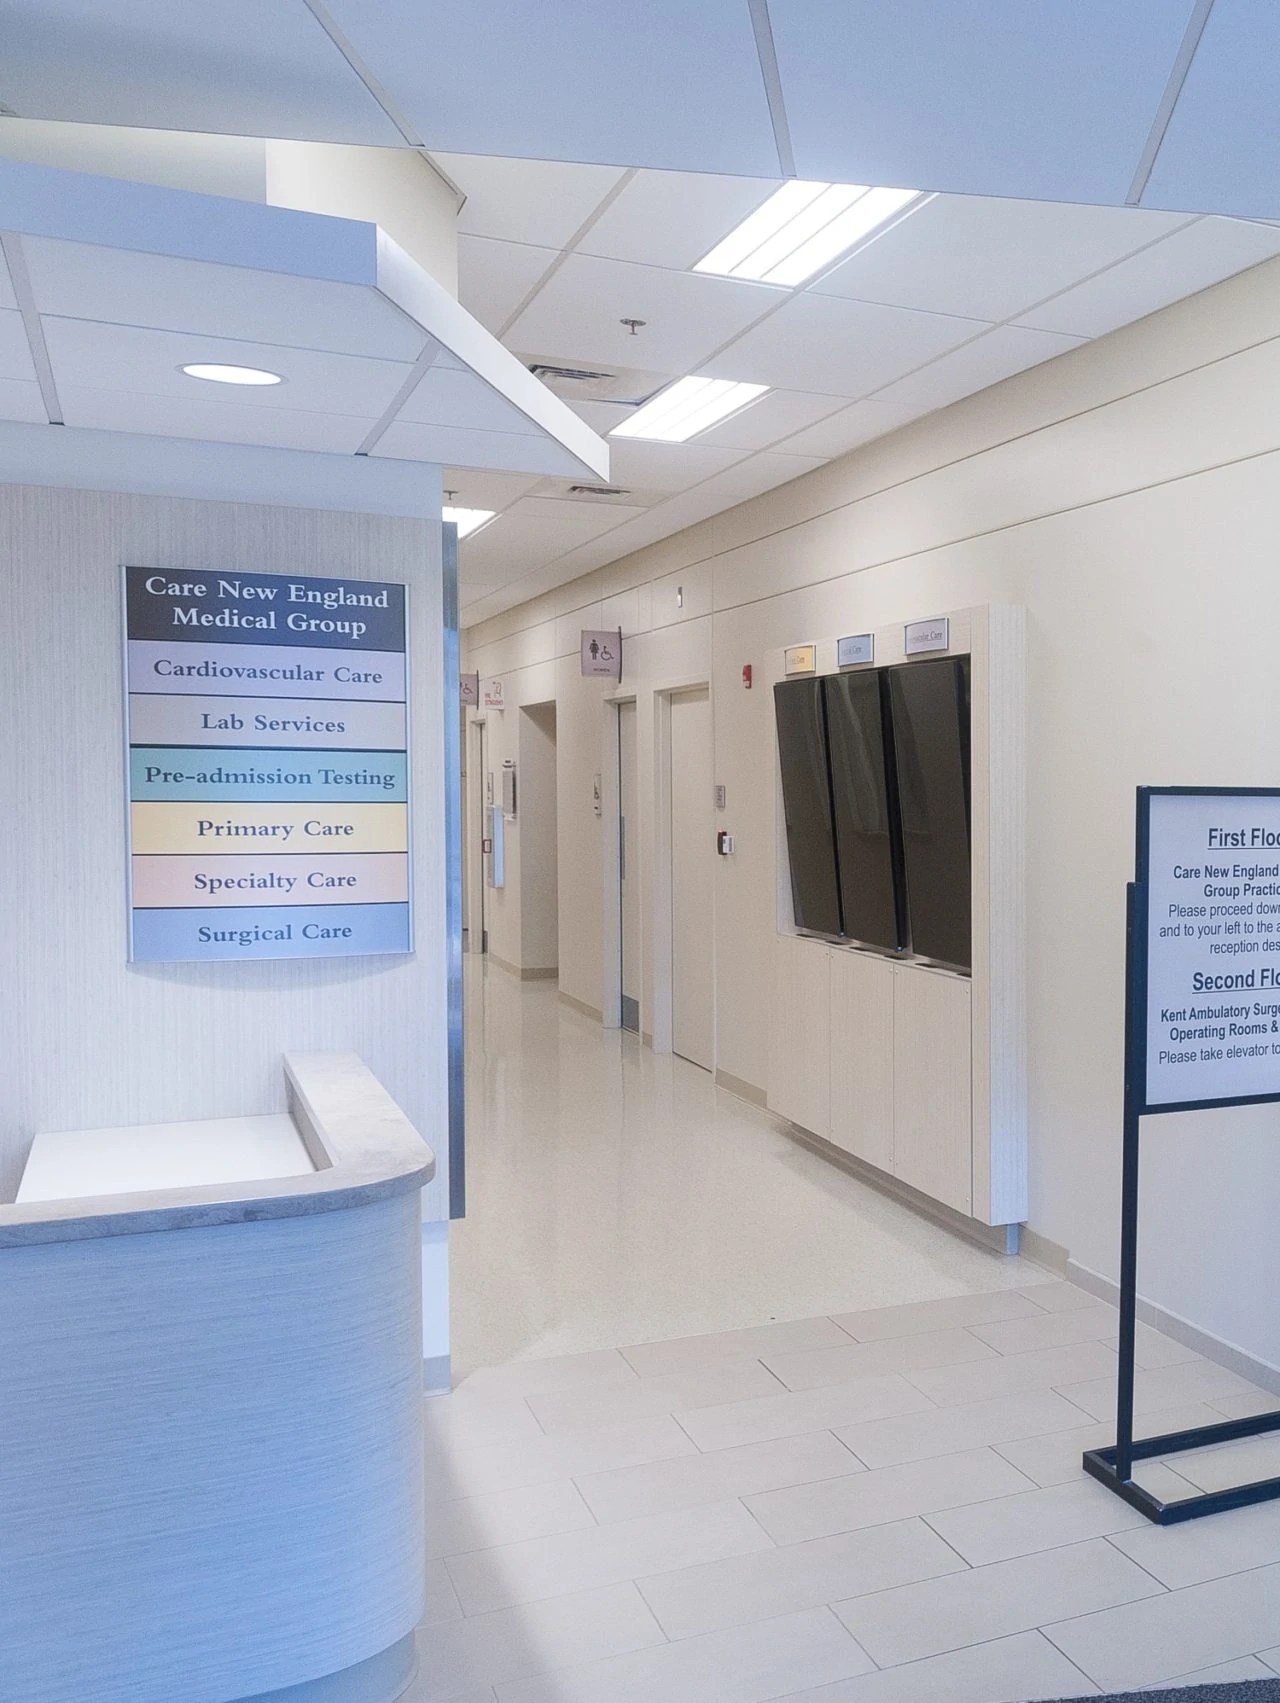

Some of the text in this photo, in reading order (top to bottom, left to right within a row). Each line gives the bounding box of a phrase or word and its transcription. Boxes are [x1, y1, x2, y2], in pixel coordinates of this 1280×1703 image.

[145, 576, 389, 609] Care New England
[172, 606, 367, 640] Medical Group
[153, 658, 384, 685] Cardiovascular Care
[200, 712, 346, 734] Lab Services
[144, 766, 396, 790] Pre-admission Testing
[196, 819, 354, 841] Primary Care
[1207, 827, 1246, 847] First
[193, 872, 358, 894] Specialty Care
[1173, 865, 1201, 879] Care
[1204, 864, 1230, 879] New
[1232, 864, 1279, 881] England
[1203, 884, 1240, 900] Group
[1168, 903, 1207, 918] Please
[1209, 902, 1253, 920] proceed
[198, 923, 353, 947] Surgical Care
[1159, 923, 1181, 938] and
[1184, 924, 1195, 937] to
[1197, 924, 1222, 939] your
[1224, 921, 1241, 935] left
[1243, 921, 1254, 934] to
[1257, 919, 1274, 933] the
[1209, 939, 1259, 956] reception
[1192, 969, 1255, 991] Second
[1160, 1007, 1187, 1022] Kent
[1189, 1003, 1250, 1021] Ambulatory
[1169, 1024, 1226, 1044] Operating
[1229, 1020, 1268, 1037] Rooms
[1270, 1019, 1279, 1033] &
[1159, 1049, 1197, 1065] Please
[1200, 1046, 1223, 1061] take
[1226, 1043, 1269, 1059] elevator
[1271, 1042, 1280, 1055] to
